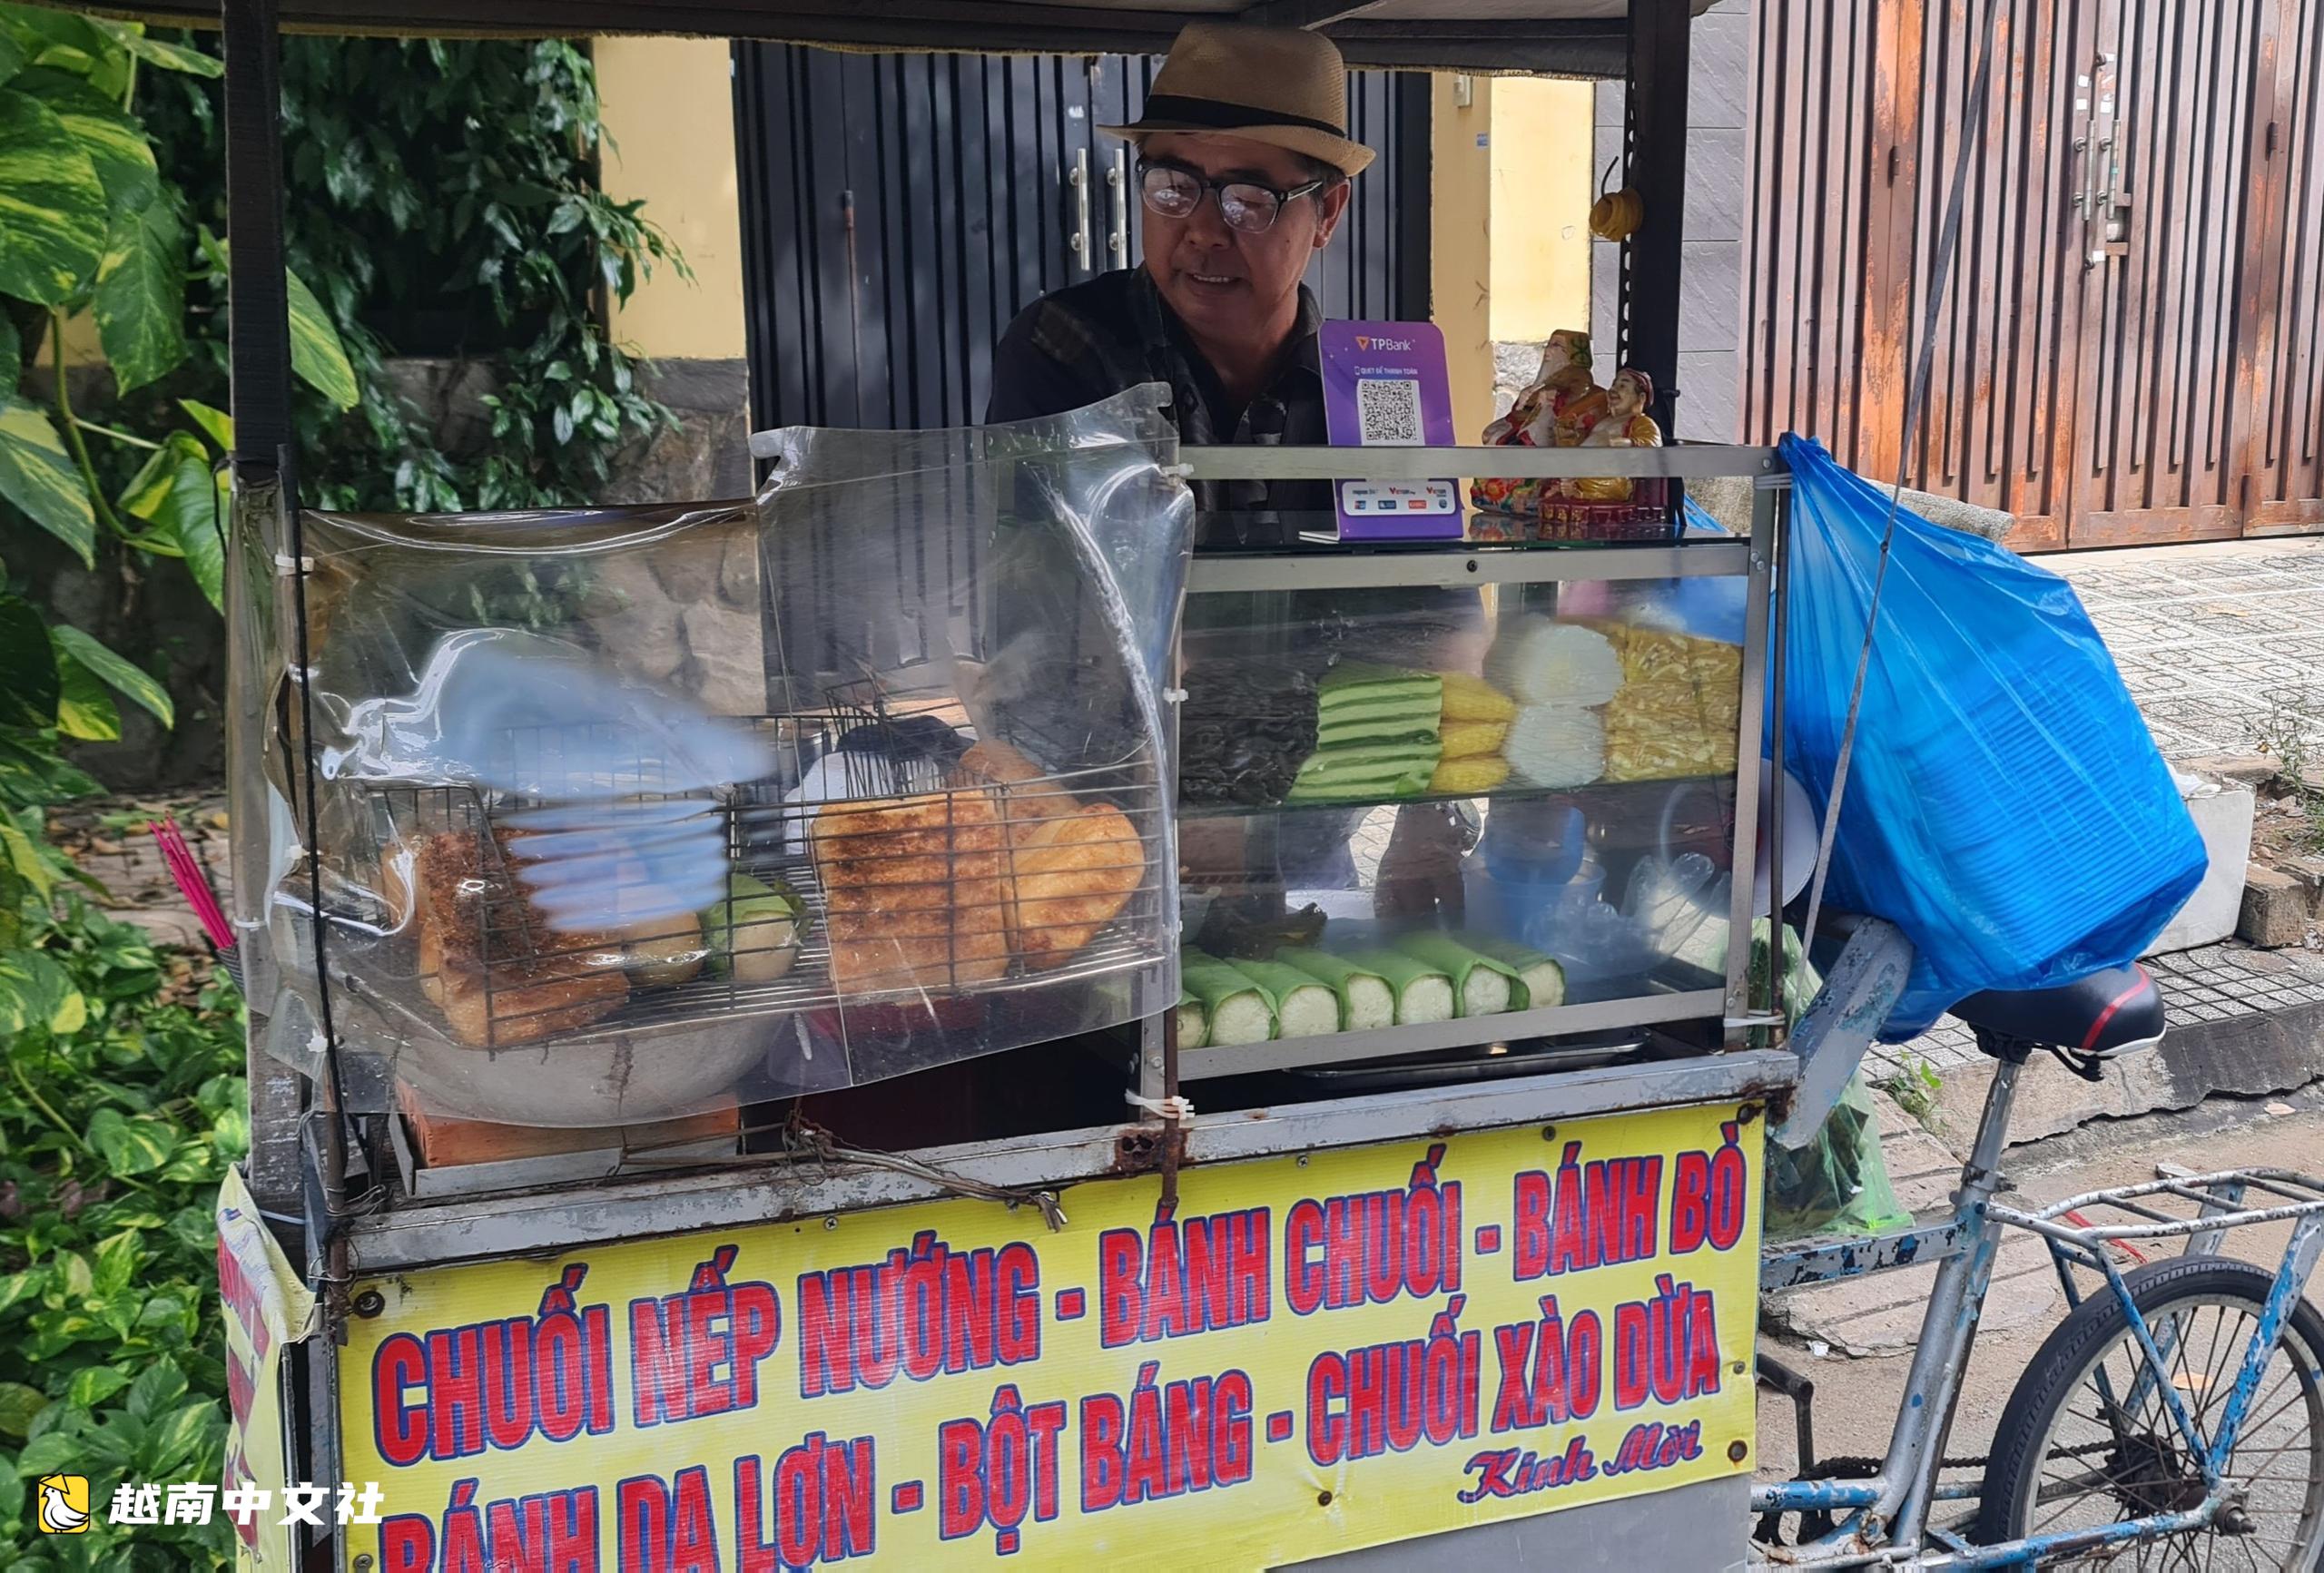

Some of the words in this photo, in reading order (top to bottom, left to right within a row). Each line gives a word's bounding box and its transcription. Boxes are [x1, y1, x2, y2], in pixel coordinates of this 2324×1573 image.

[1371, 338, 1412, 350] TPBank
[373, 1263, 615, 1467] CHUỐI
[629, 1244, 780, 1428] NẾP
[798, 1230, 1040, 1400] NƯỚNG
[1099, 1199, 1271, 1349] BÁNH
[1285, 1144, 1462, 1316] CHUỐI
[1513, 1140, 1664, 1283] BÁNH
[1669, 1120, 1747, 1255] BÒ
[616, 1464, 722, 1573] DA
[939, 1383, 1067, 1555] BỘT
[1080, 1361, 1254, 1514] BÁNG
[1306, 1293, 1481, 1467] CHUỐI
[1491, 1294, 1603, 1434] XÀO
[1614, 1273, 1721, 1412] DỪA
[1602, 1420, 1703, 1477] Mời
